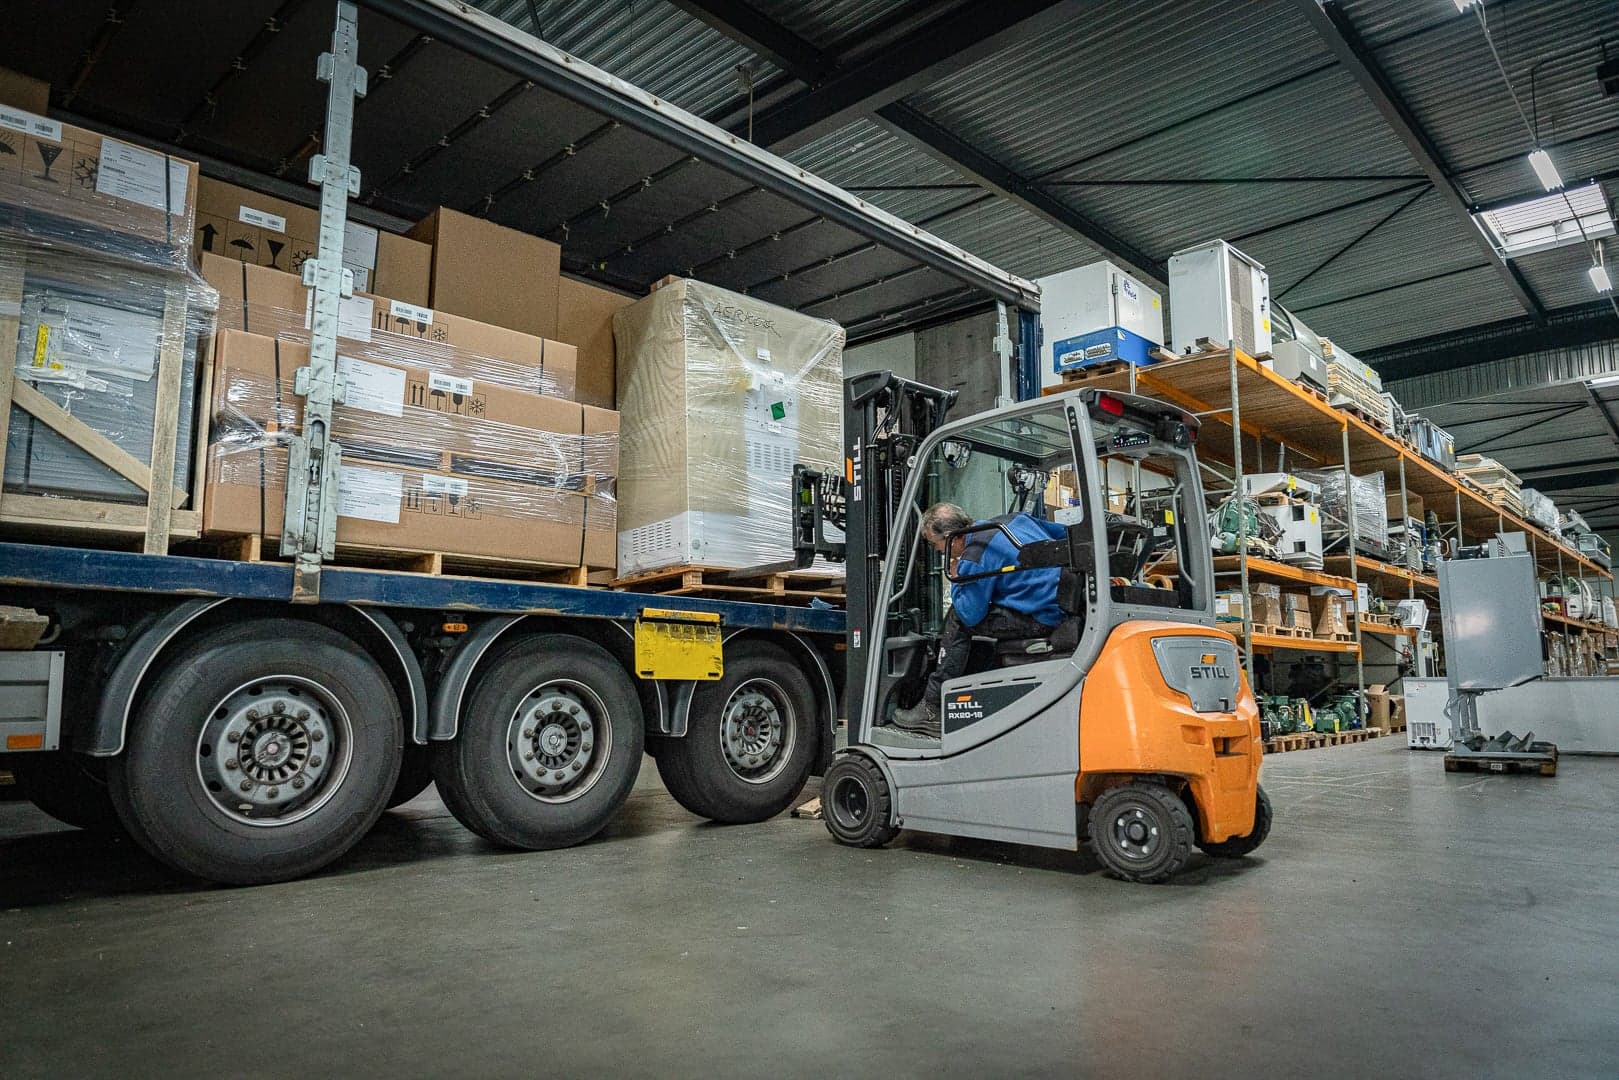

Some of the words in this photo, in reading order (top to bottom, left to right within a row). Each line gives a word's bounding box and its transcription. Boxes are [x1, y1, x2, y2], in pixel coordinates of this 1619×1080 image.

[853, 436, 862, 502] STILL
[1190, 666, 1230, 679] STILL
[947, 701, 983, 710] STILL
